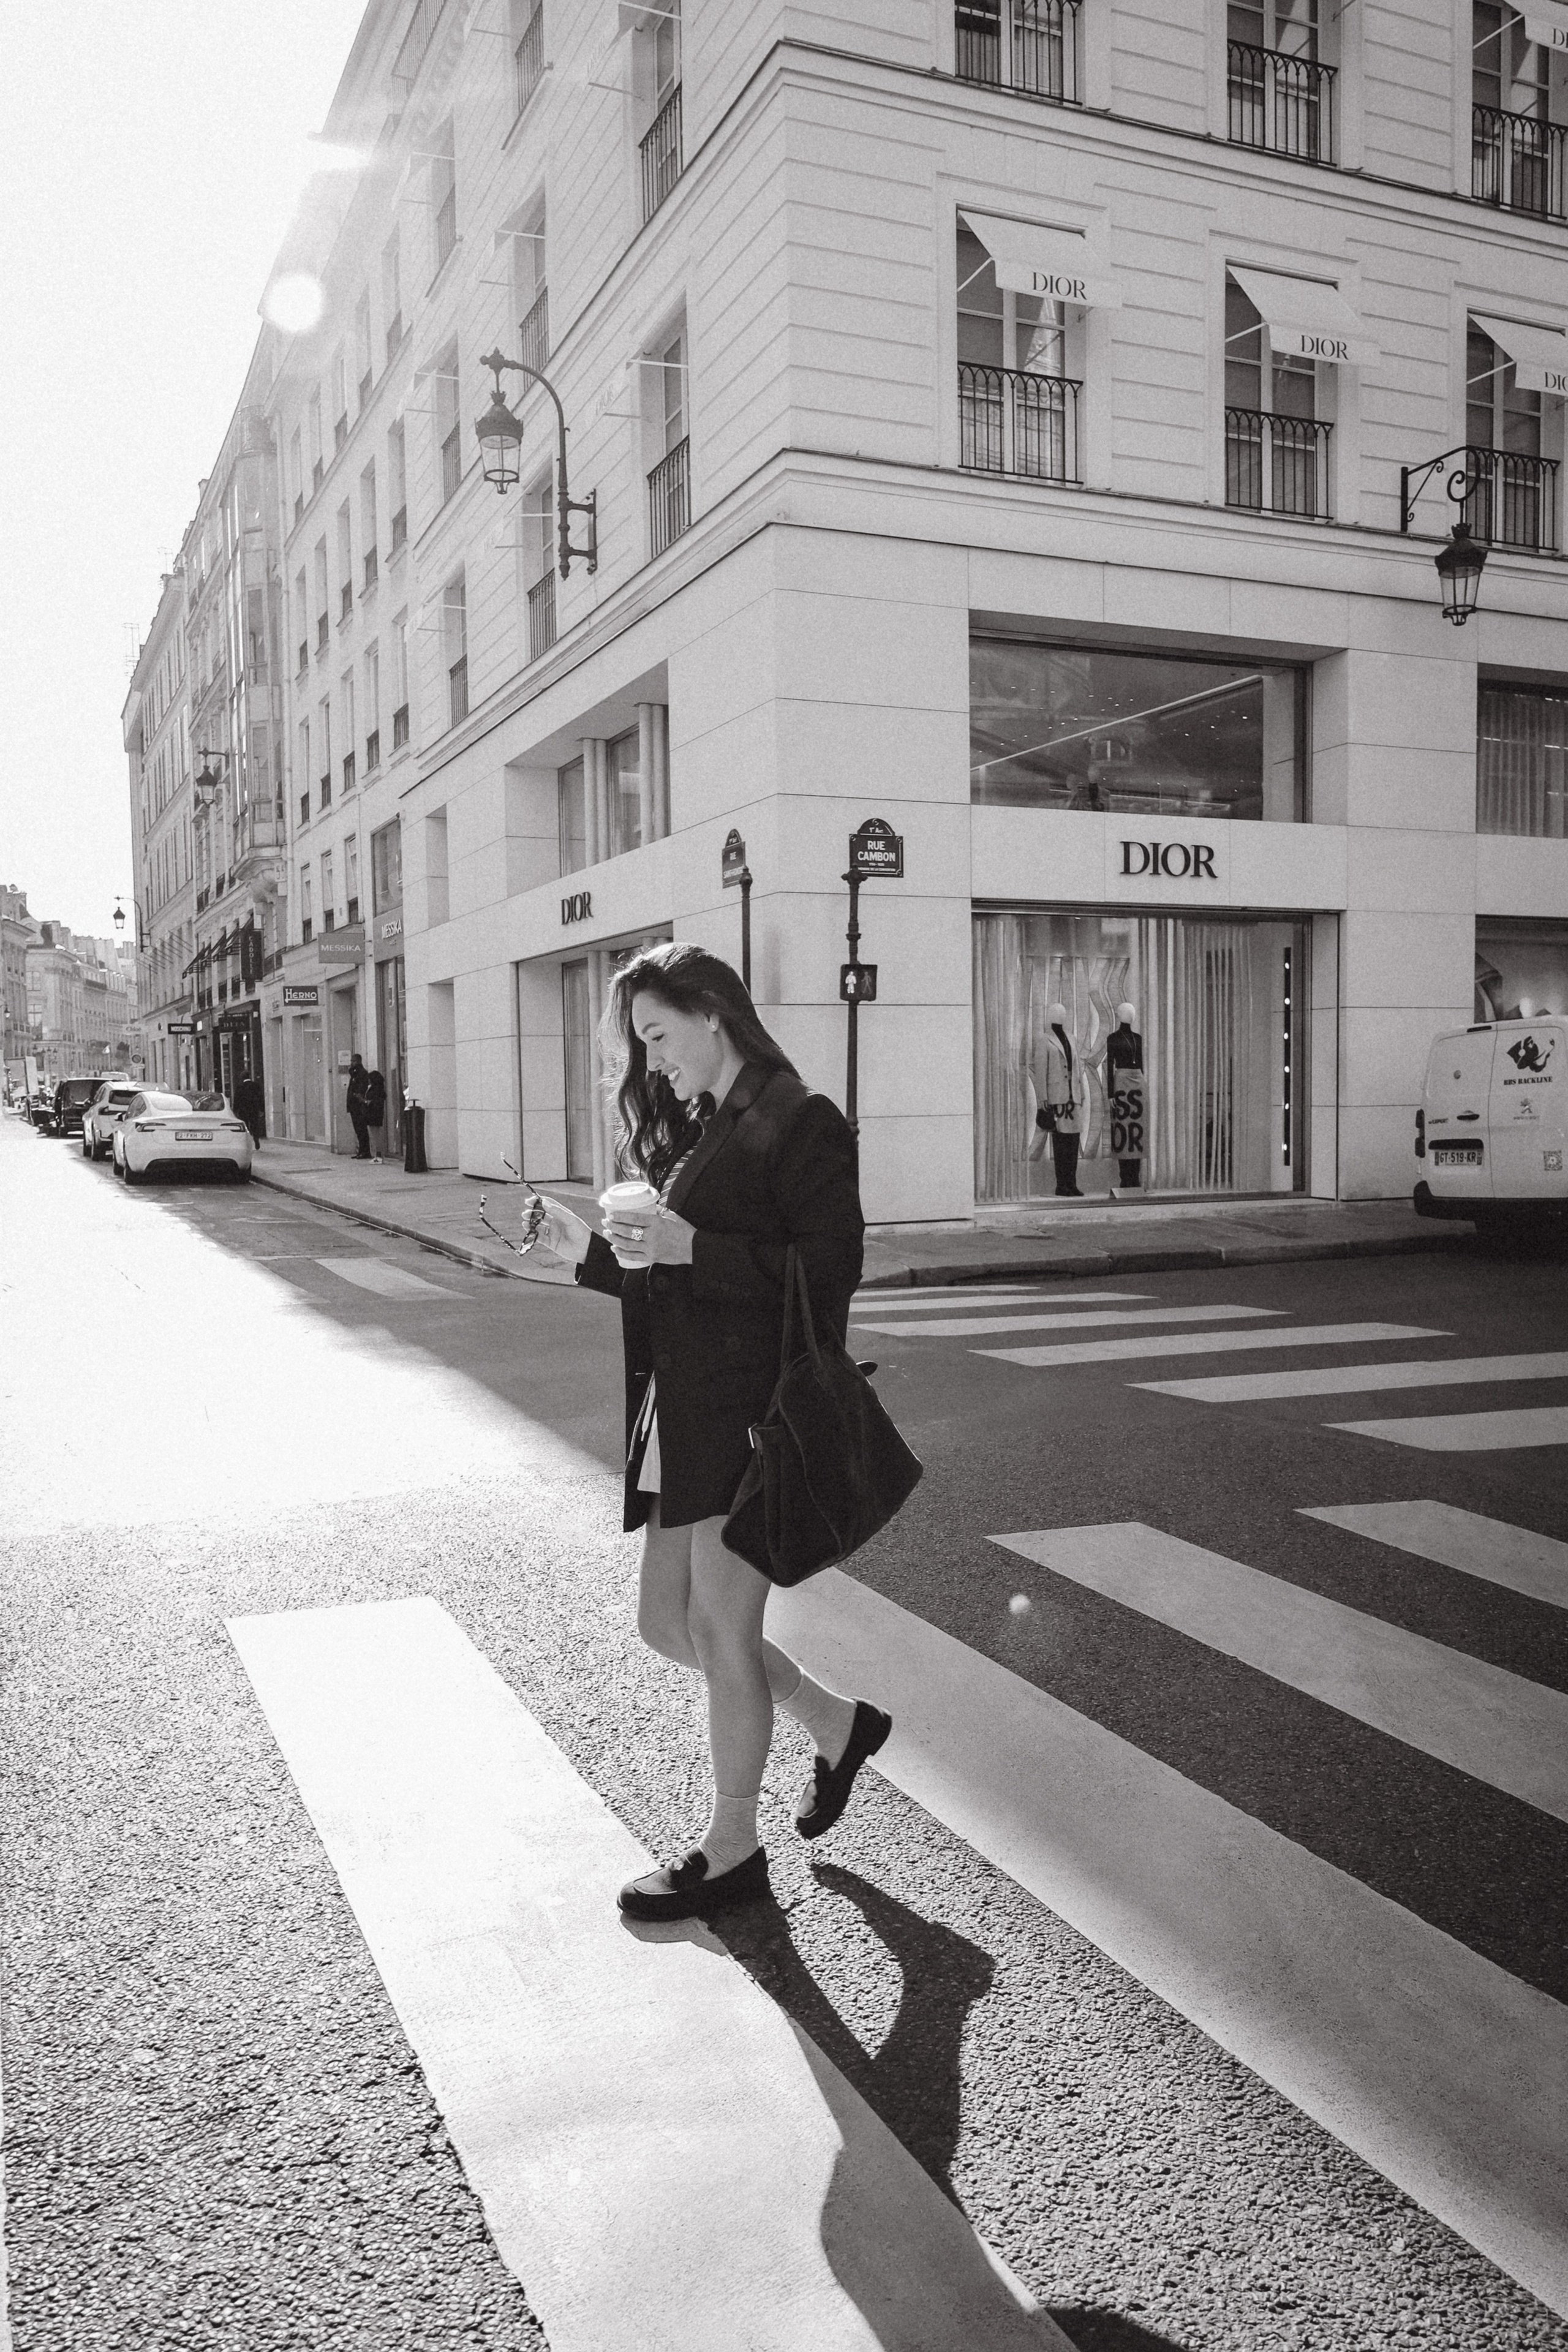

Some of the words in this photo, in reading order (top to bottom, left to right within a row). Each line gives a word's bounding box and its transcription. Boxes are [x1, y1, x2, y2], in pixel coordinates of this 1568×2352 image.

[1031, 271, 1087, 300] DIOR
[1301, 334, 1349, 360] DIOR
[858, 851, 895, 862] CAMBON
[867, 840, 886, 851] RUE
[1120, 841, 1218, 878] DIOR
[560, 892, 594, 925] DIOR
[1439, 1152, 1476, 1163] GT-519-KR
